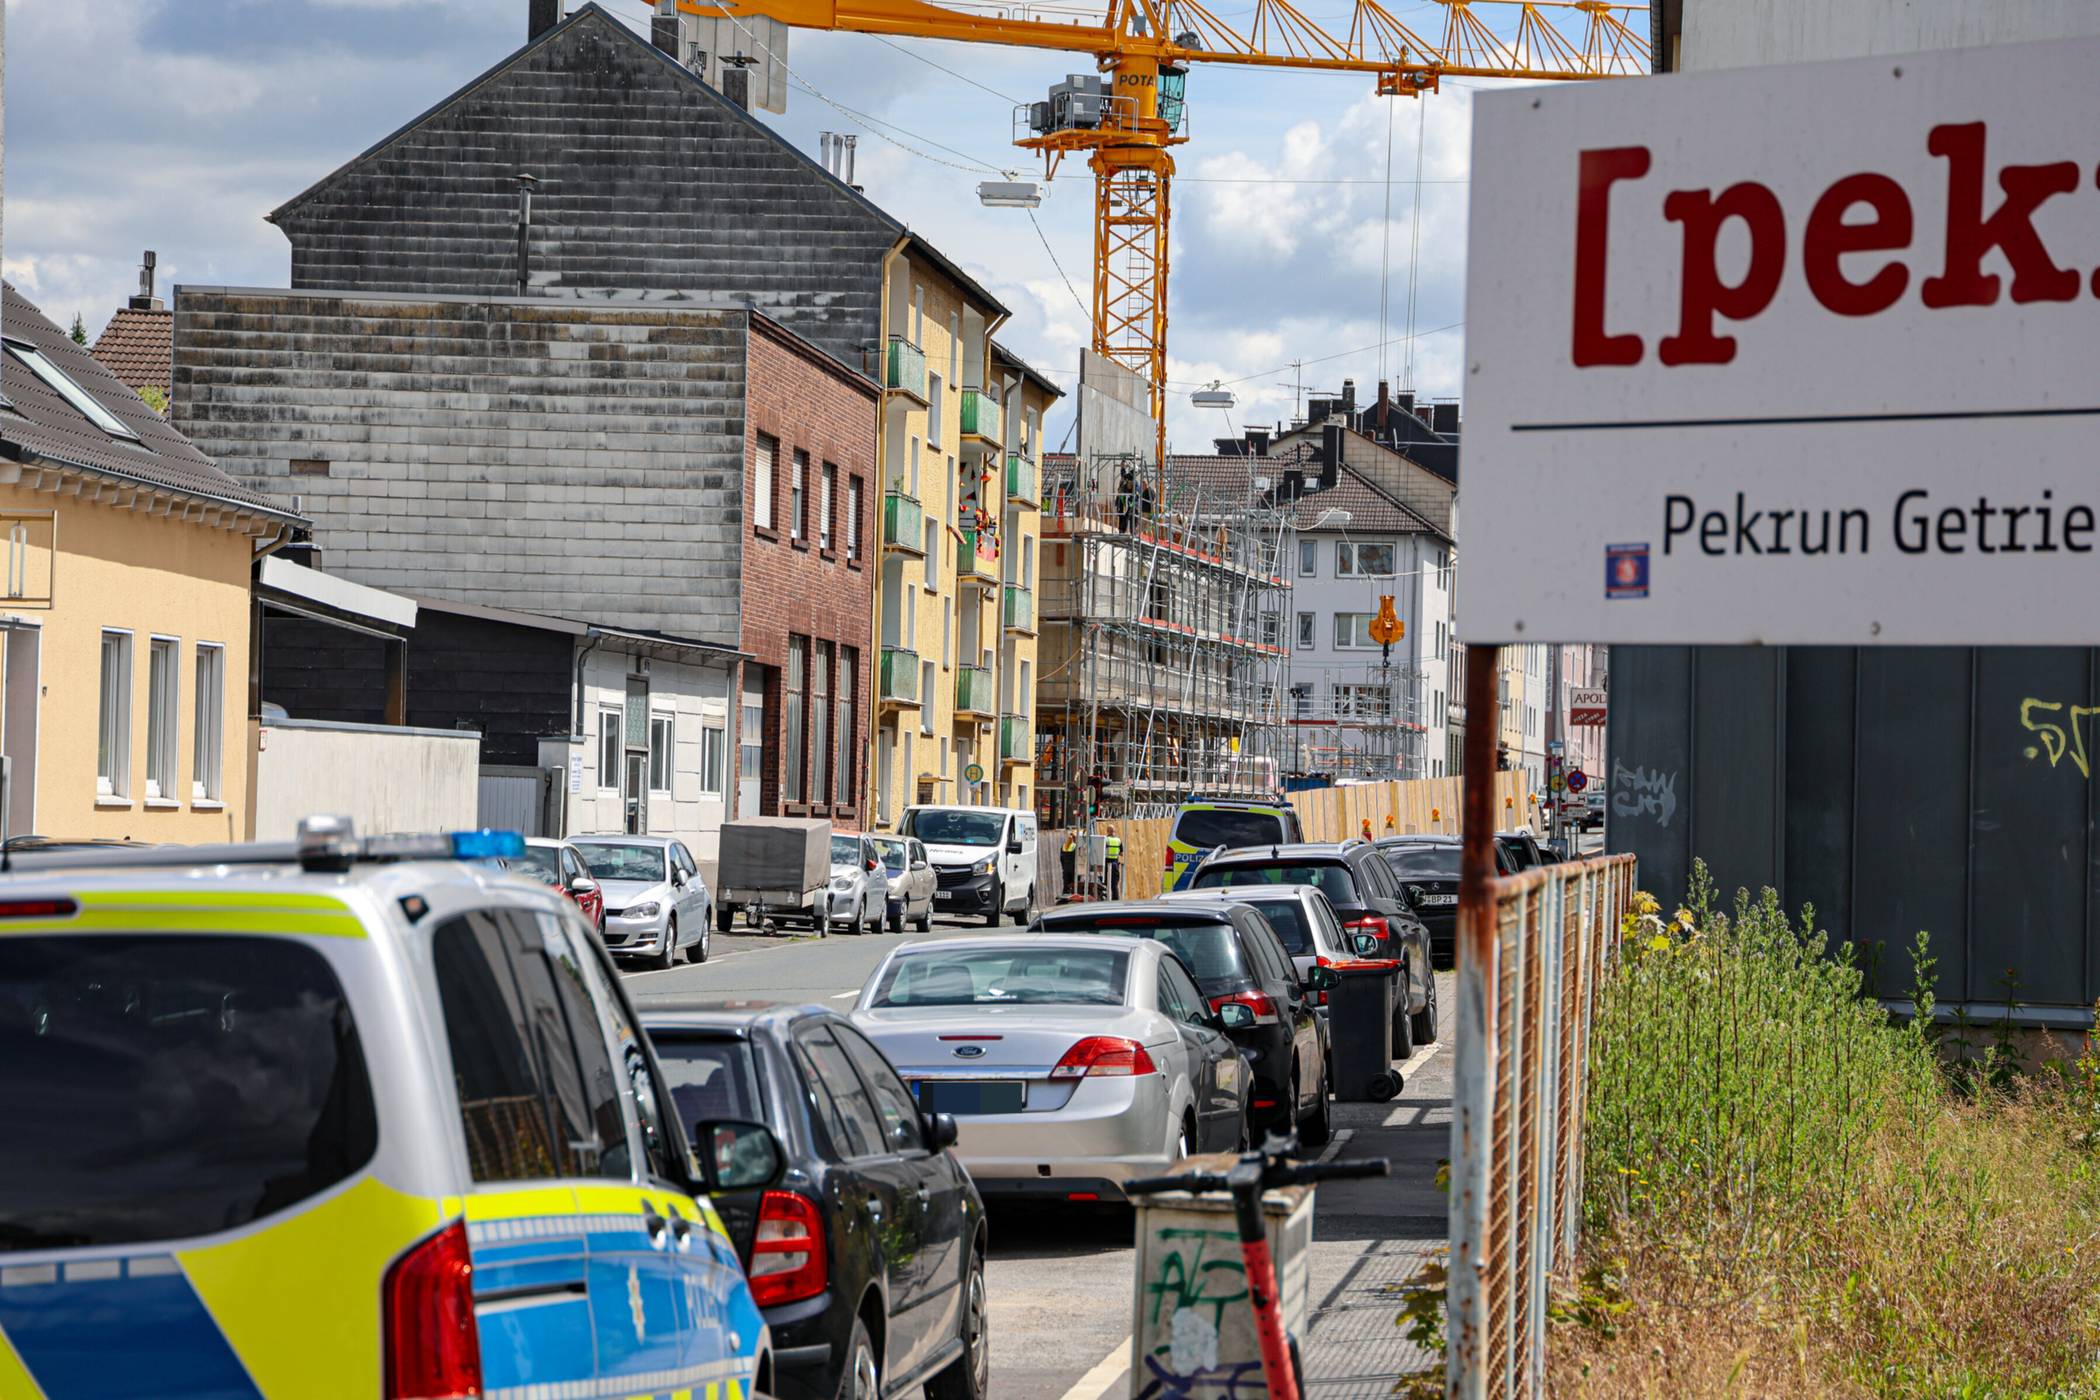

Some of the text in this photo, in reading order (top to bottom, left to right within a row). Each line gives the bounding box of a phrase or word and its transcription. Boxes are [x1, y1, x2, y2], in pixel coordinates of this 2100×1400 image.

[1119, 74, 1154, 86] POTA
[1572, 121, 2100, 367] [pek
[1663, 489, 2096, 556] Pekrun Getrie
[1442, 895, 1452, 903] 21
